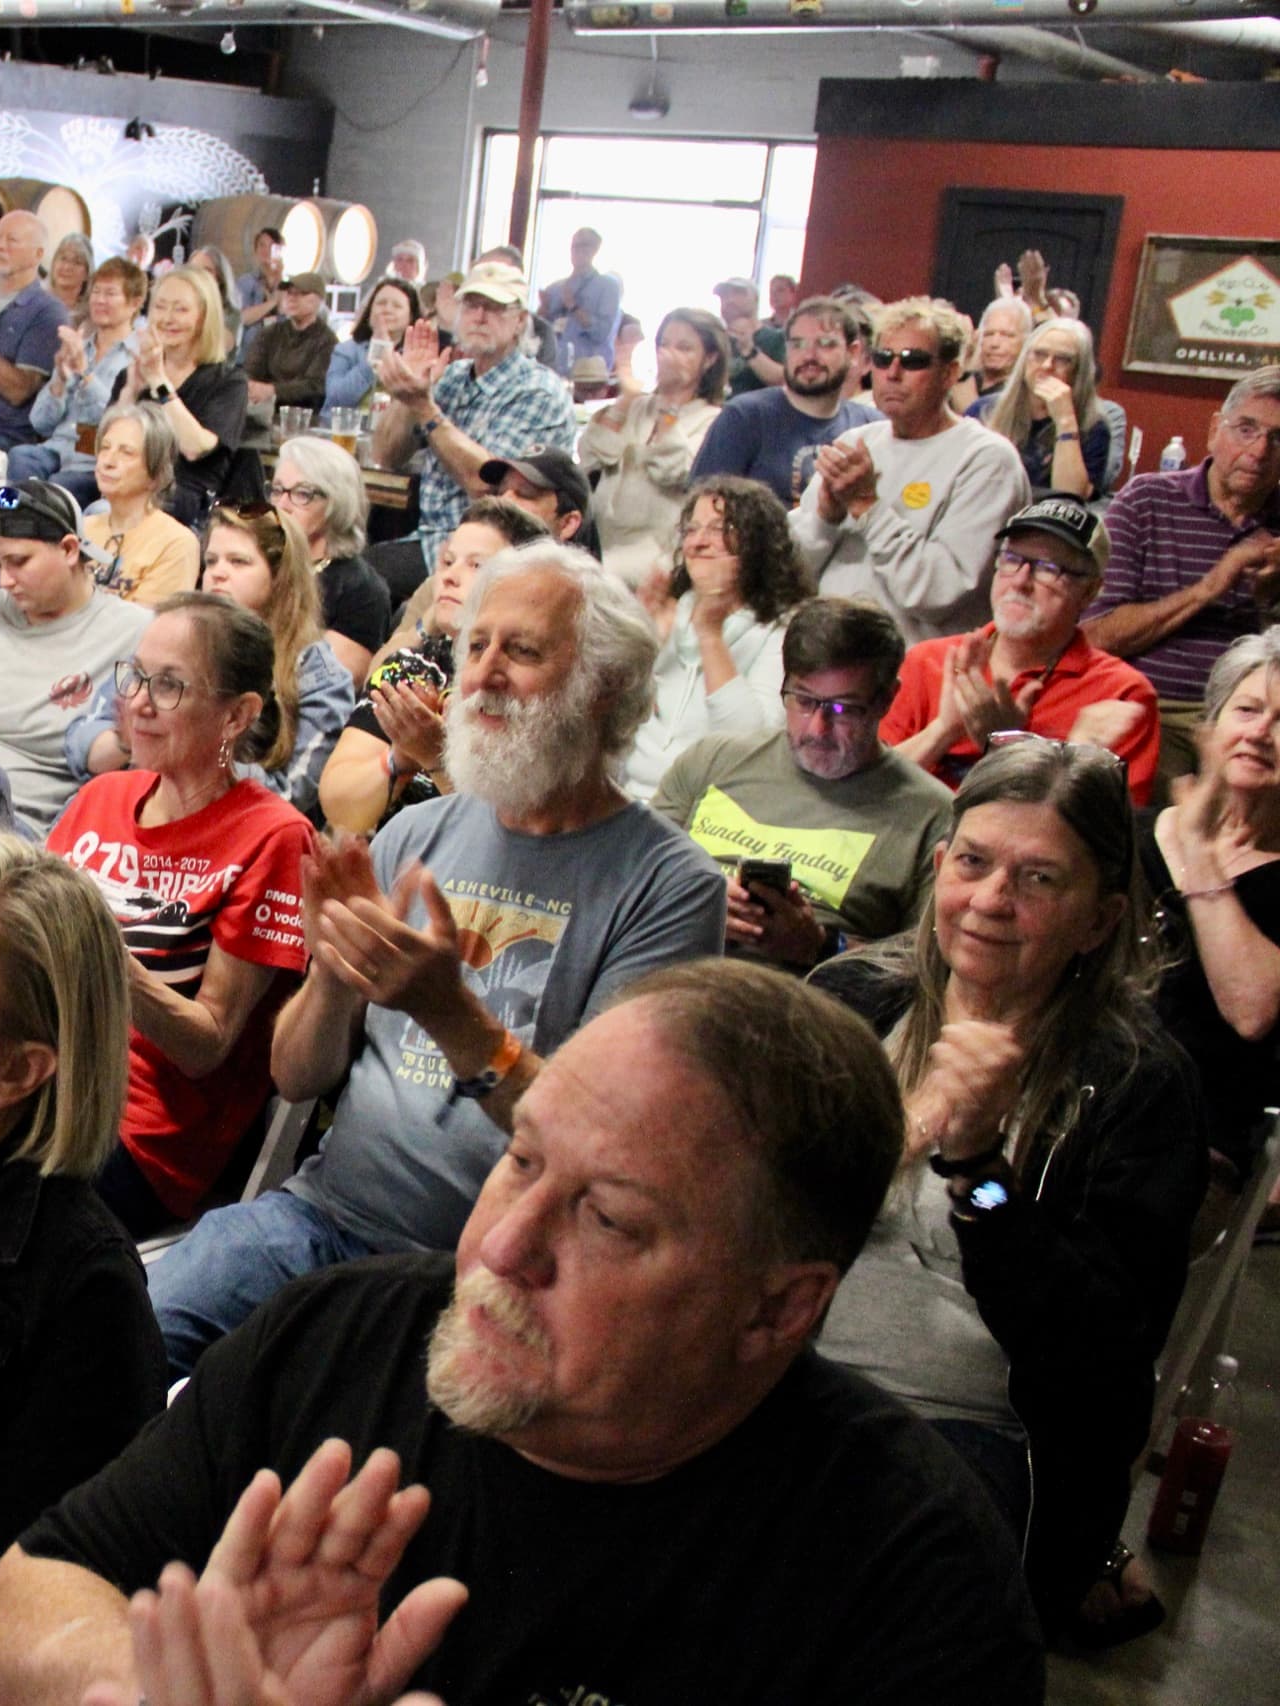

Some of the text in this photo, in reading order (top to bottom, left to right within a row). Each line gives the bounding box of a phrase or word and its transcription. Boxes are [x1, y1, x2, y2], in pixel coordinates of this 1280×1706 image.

[1175, 347, 1253, 366] OPELIKA,
[694, 817, 850, 882] Sunday Funday
[401, 1051, 448, 1073] BLUE
